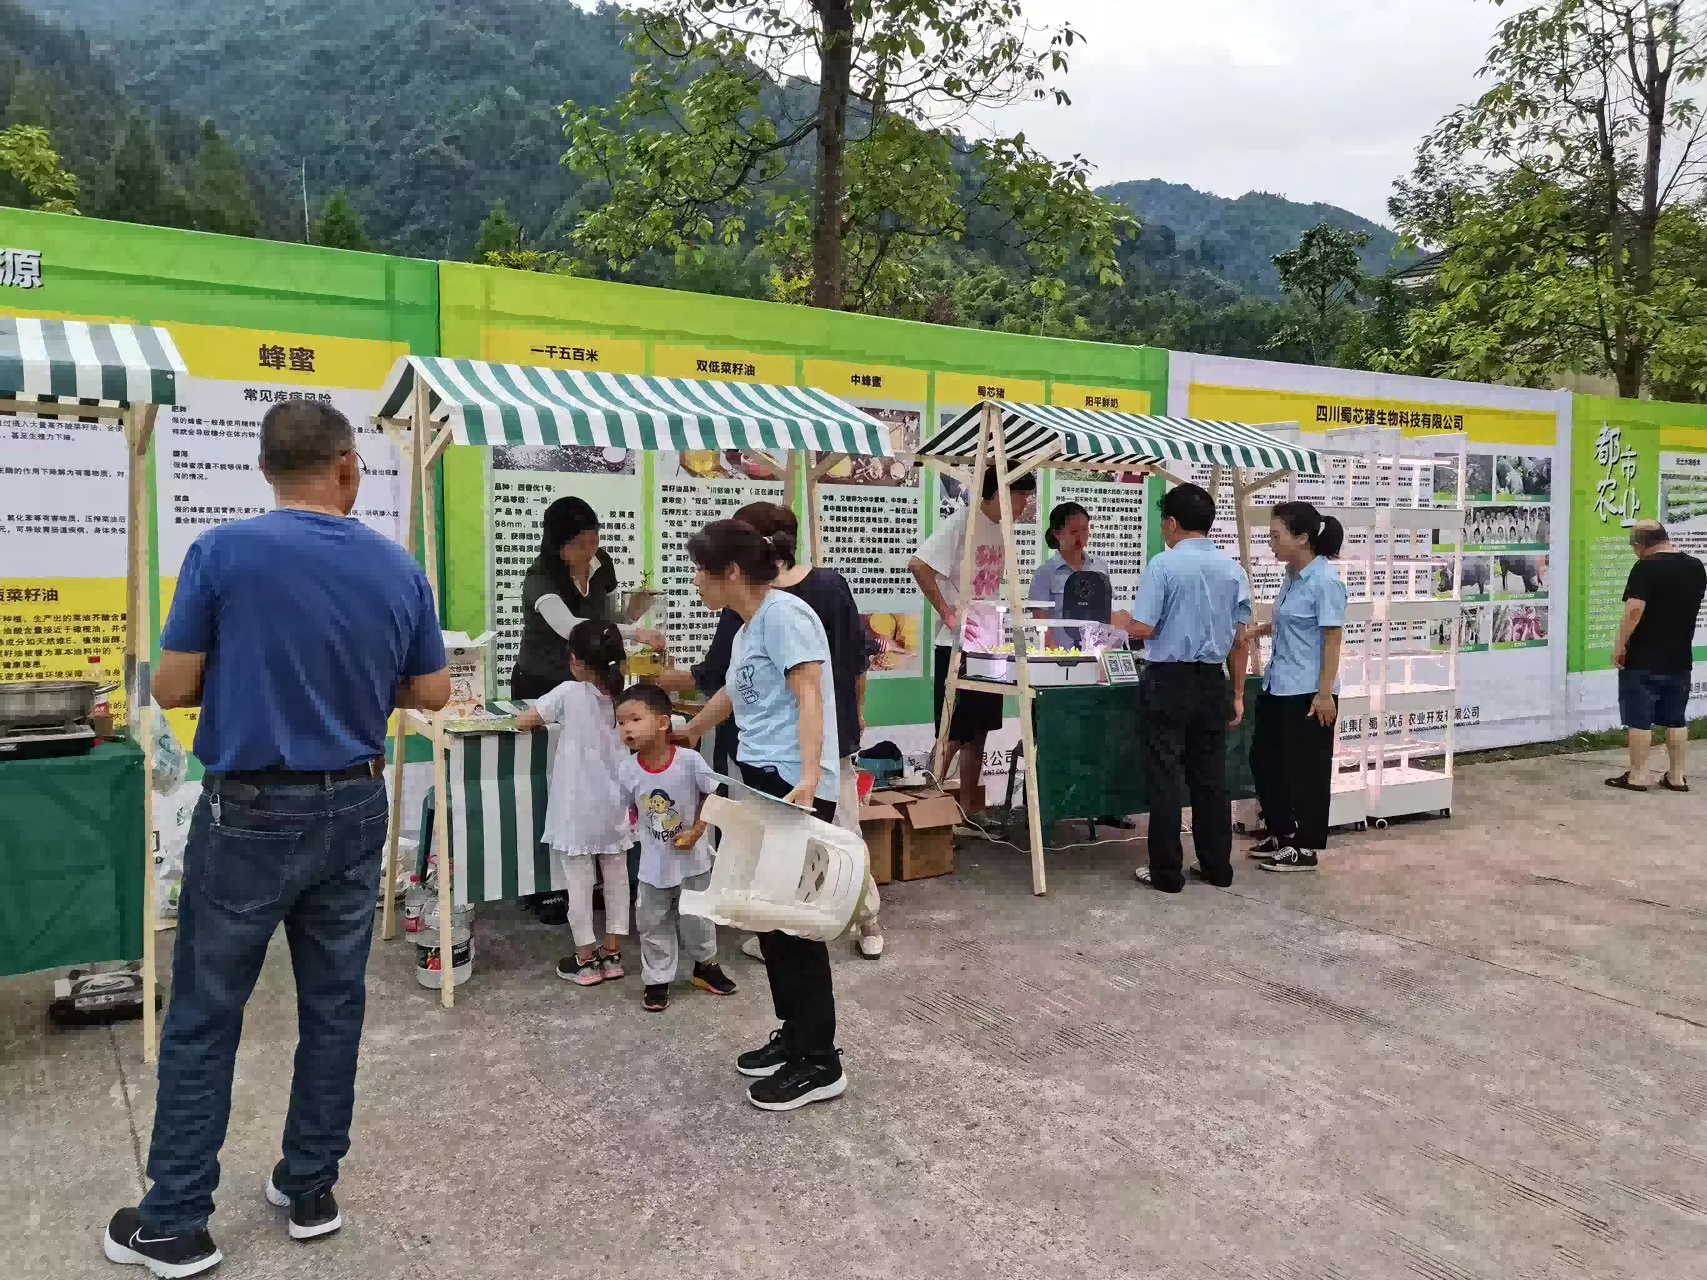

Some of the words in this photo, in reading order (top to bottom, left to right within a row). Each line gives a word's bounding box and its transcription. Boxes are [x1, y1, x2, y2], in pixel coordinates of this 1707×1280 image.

[0, 248, 43, 290] 源
[258, 344, 316, 373] 蜂蜜
[530, 346, 599, 363] 一千五百米
[696, 359, 756, 377] 双低菜籽油
[850, 373, 882, 389] 中蜂蜜
[977, 386, 1006, 399] 蜀芯猪
[1085, 396, 1119, 409] 阳平鲜奶
[1315, 404, 1464, 431] 四川蜀芯猪生物科技有限公司
